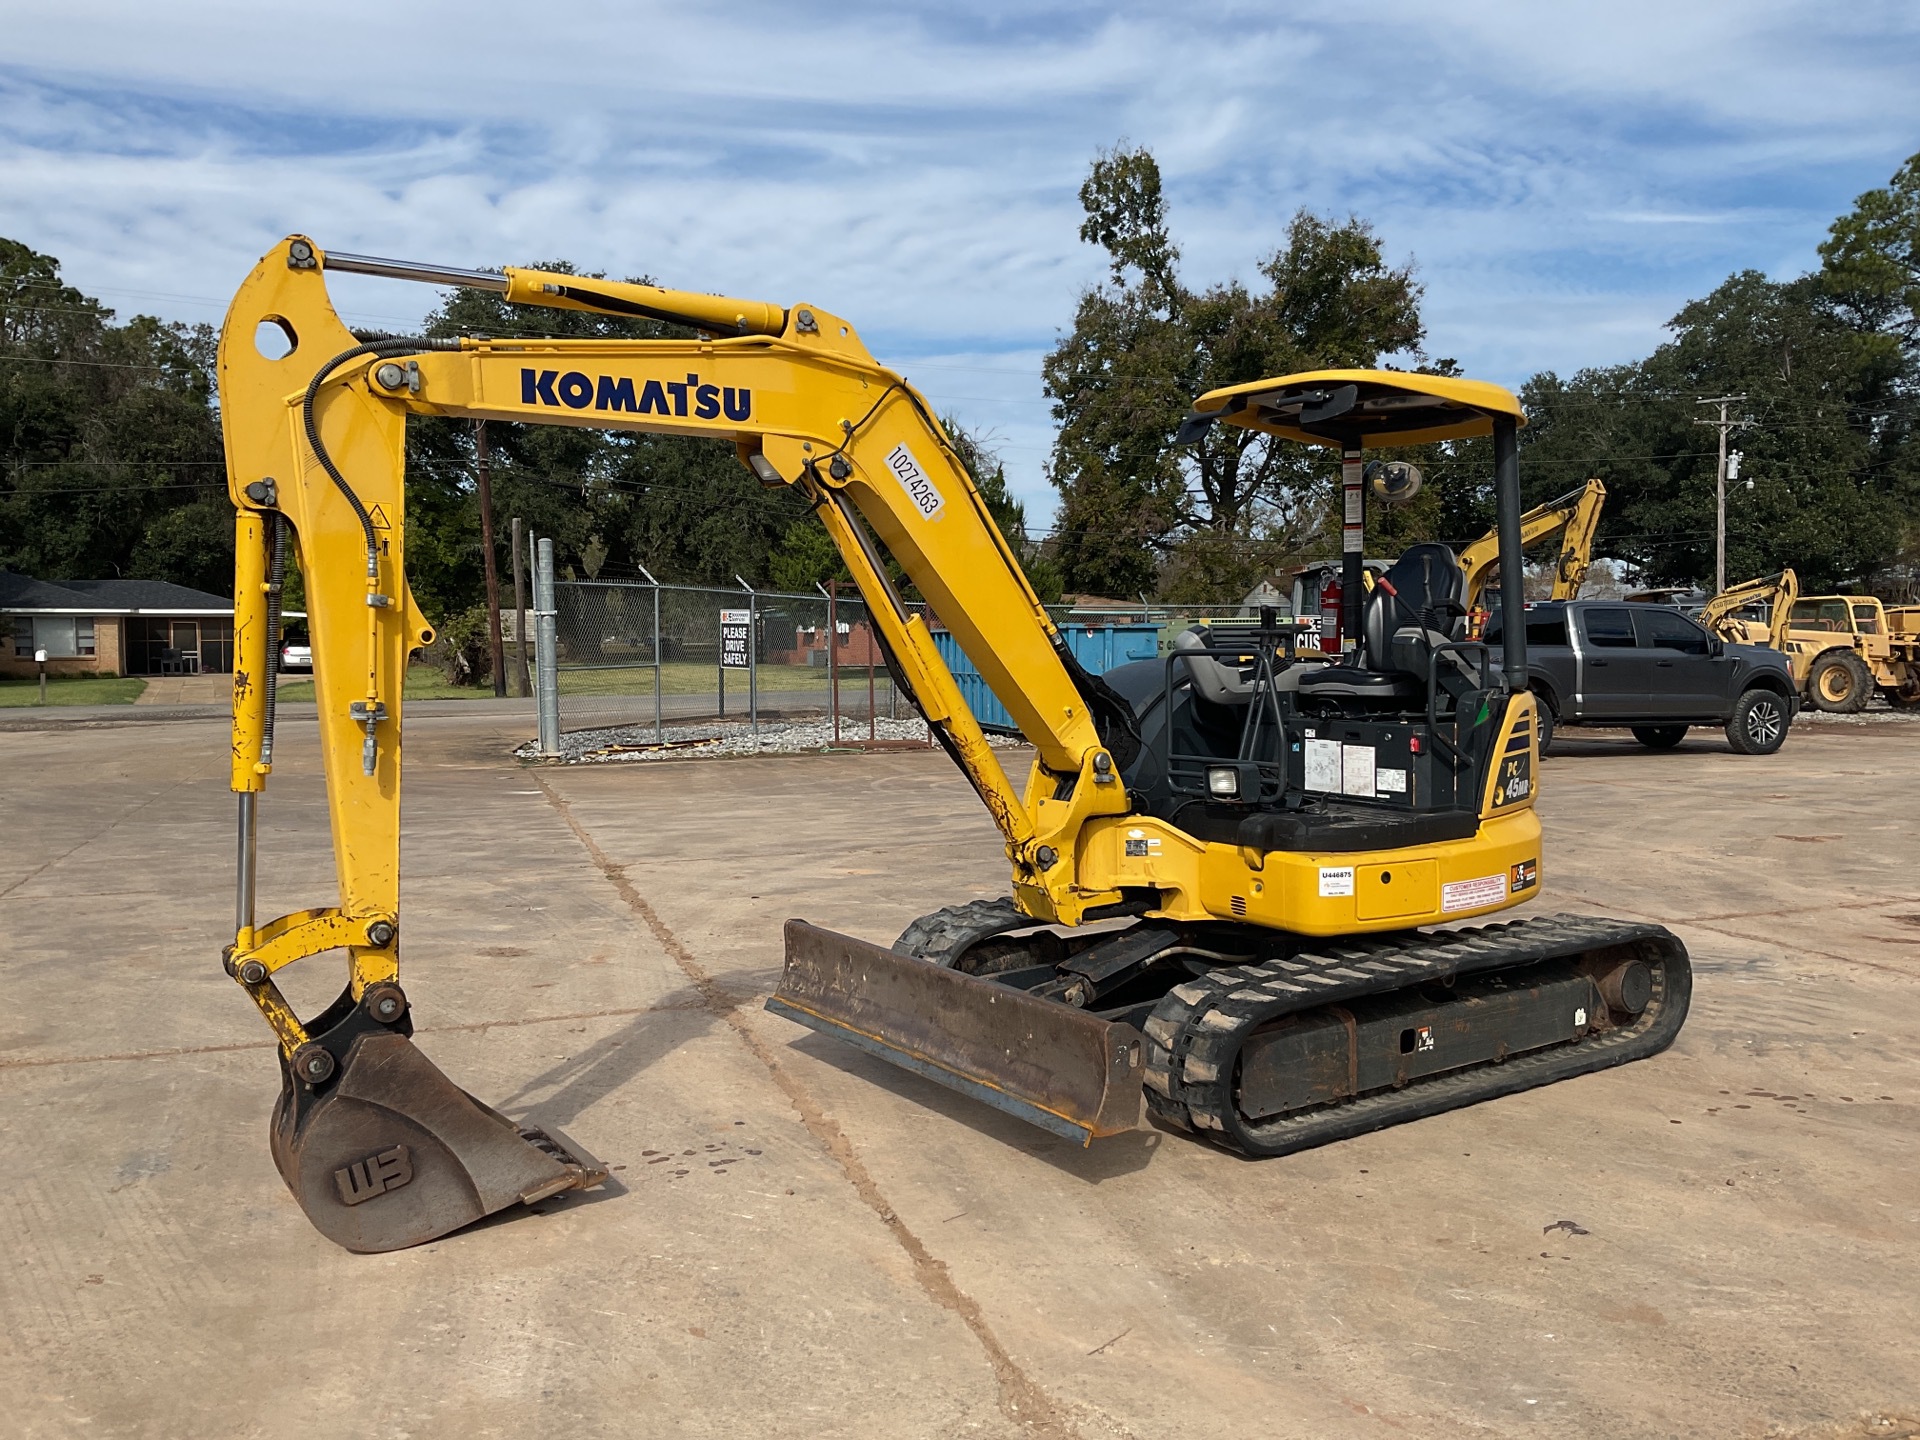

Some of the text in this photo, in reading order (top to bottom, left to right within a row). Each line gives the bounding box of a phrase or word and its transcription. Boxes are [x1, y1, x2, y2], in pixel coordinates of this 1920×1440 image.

[521, 368, 751, 421] KOMATSU
[888, 446, 939, 514] 10274263
[723, 627, 747, 639] PLEASE
[725, 640, 745, 652] DRIVE
[723, 653, 747, 665] SAFELY
[1507, 760, 1518, 777] PC
